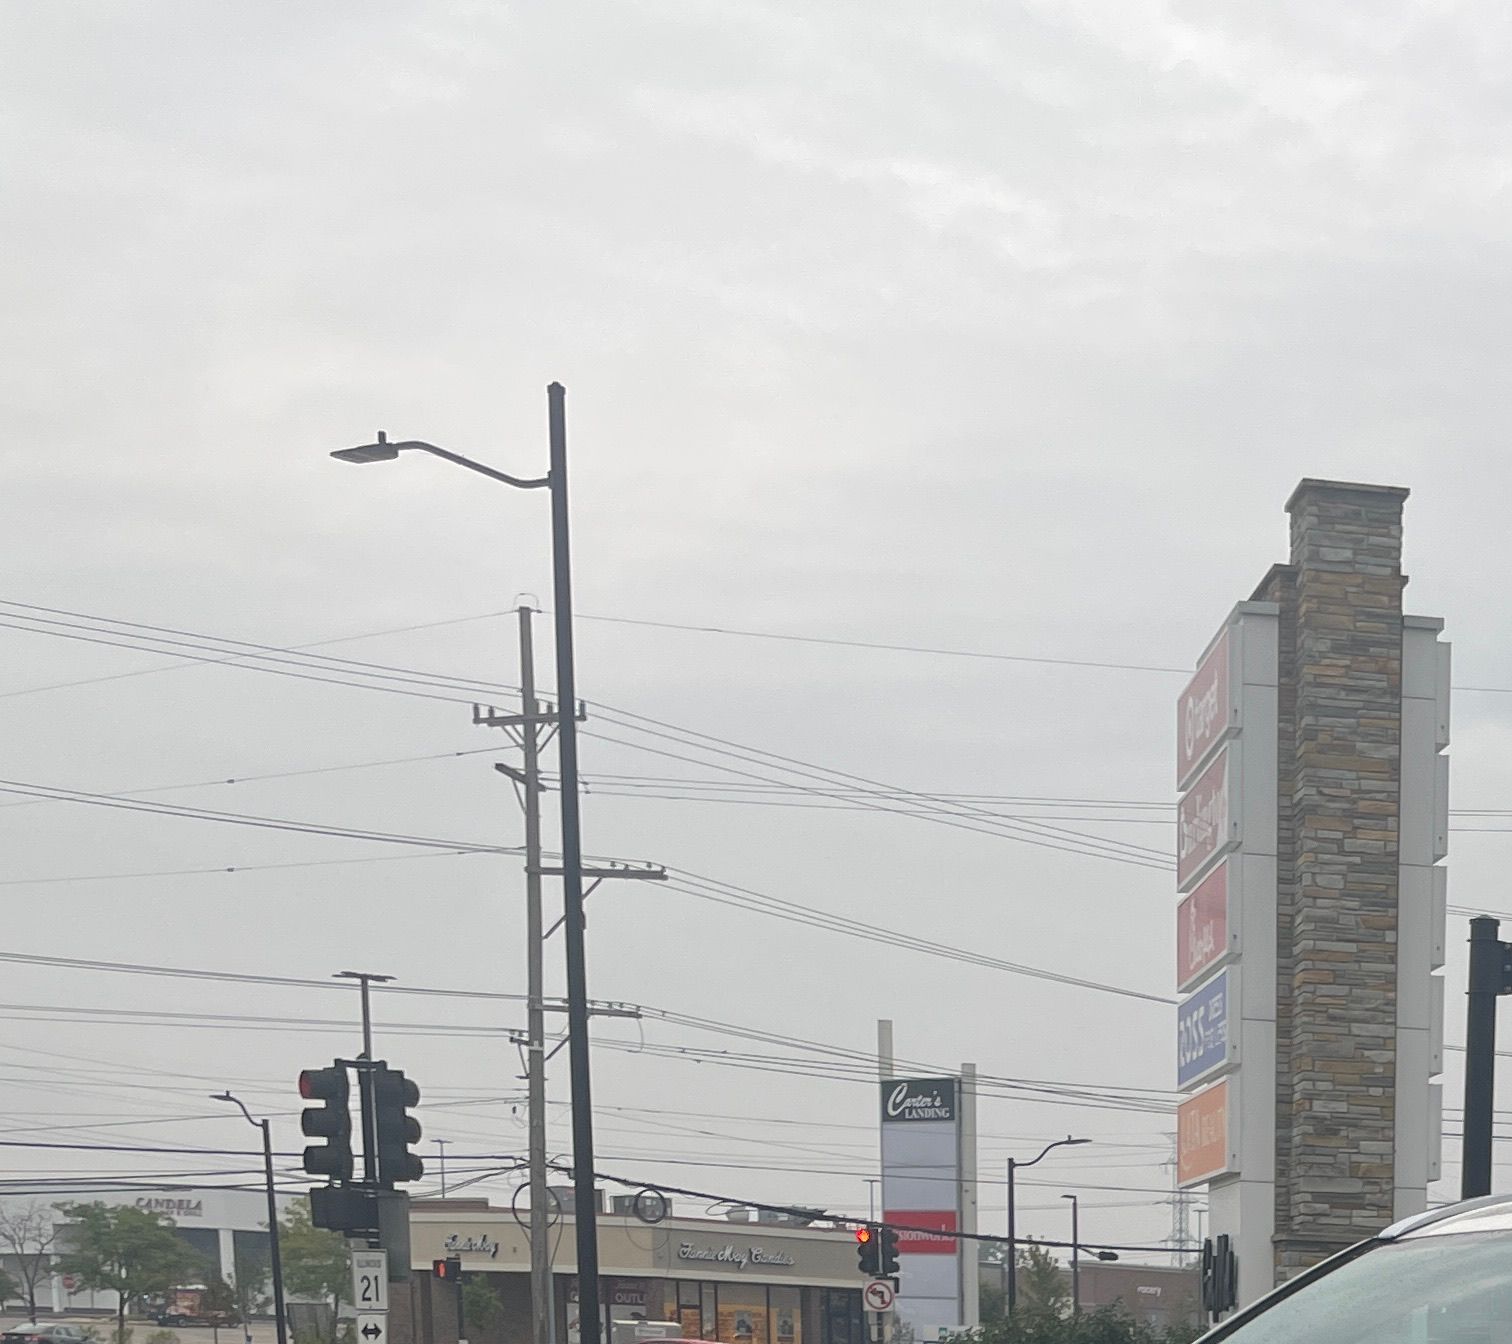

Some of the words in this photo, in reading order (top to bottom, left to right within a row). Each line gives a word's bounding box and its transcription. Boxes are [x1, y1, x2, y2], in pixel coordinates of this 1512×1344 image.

[887, 1082, 943, 1117] Carter's
[904, 1107, 951, 1119] LANDING
[360, 1274, 380, 1302] 21
